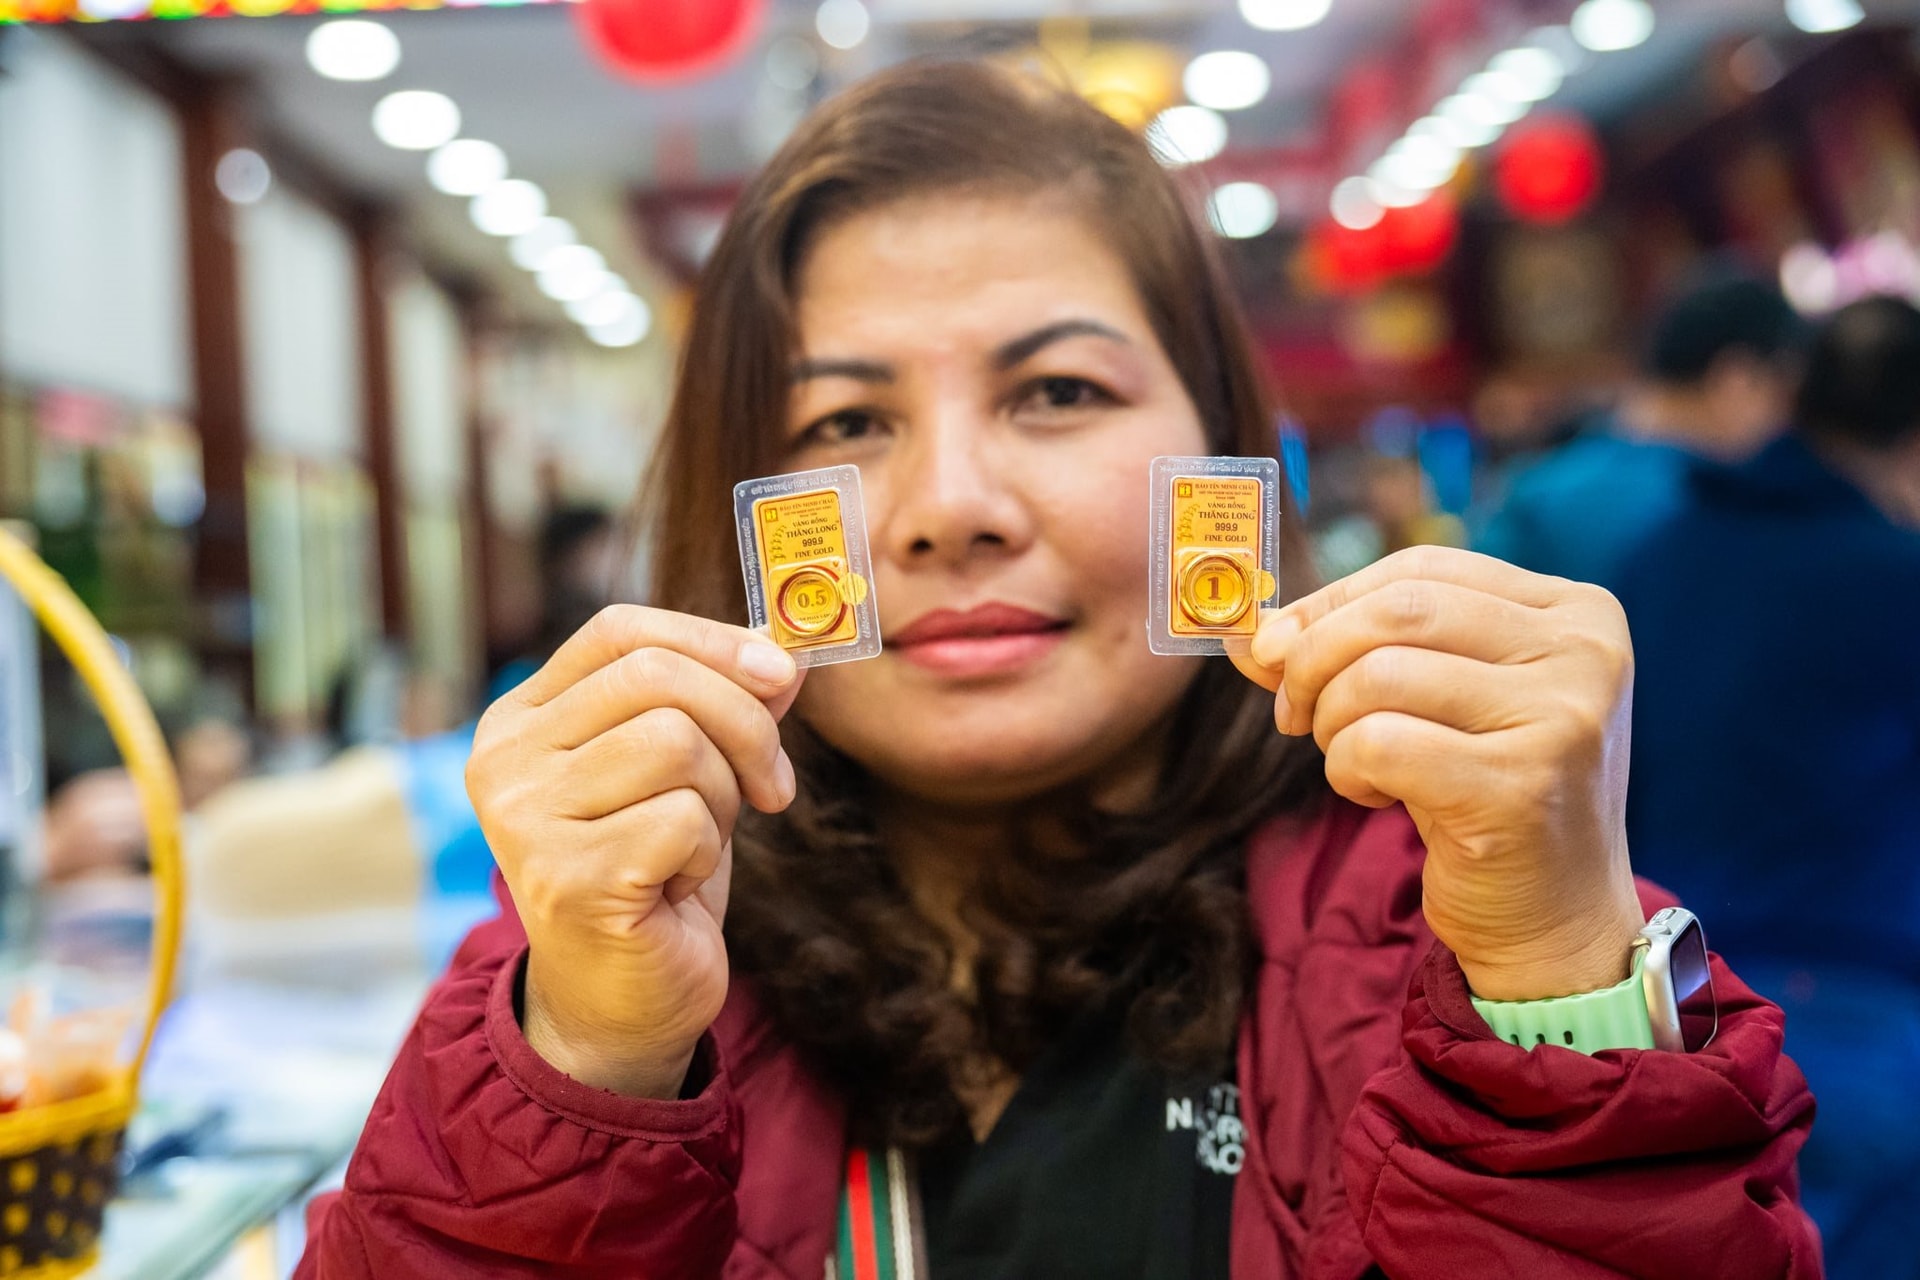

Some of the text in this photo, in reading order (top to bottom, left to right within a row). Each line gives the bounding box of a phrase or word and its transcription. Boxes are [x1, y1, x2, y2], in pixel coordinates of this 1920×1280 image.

[1231, 511, 1255, 520] LONG
[815, 523, 838, 534] LONG
[1214, 522, 1238, 532] 999.9
[802, 537, 823, 547] 999.9
[1204, 534, 1248, 542] FINE GOLD
[795, 546, 834, 559] FINE GOLD
[1207, 576, 1222, 600] 1
[797, 589, 827, 608] 0.5
